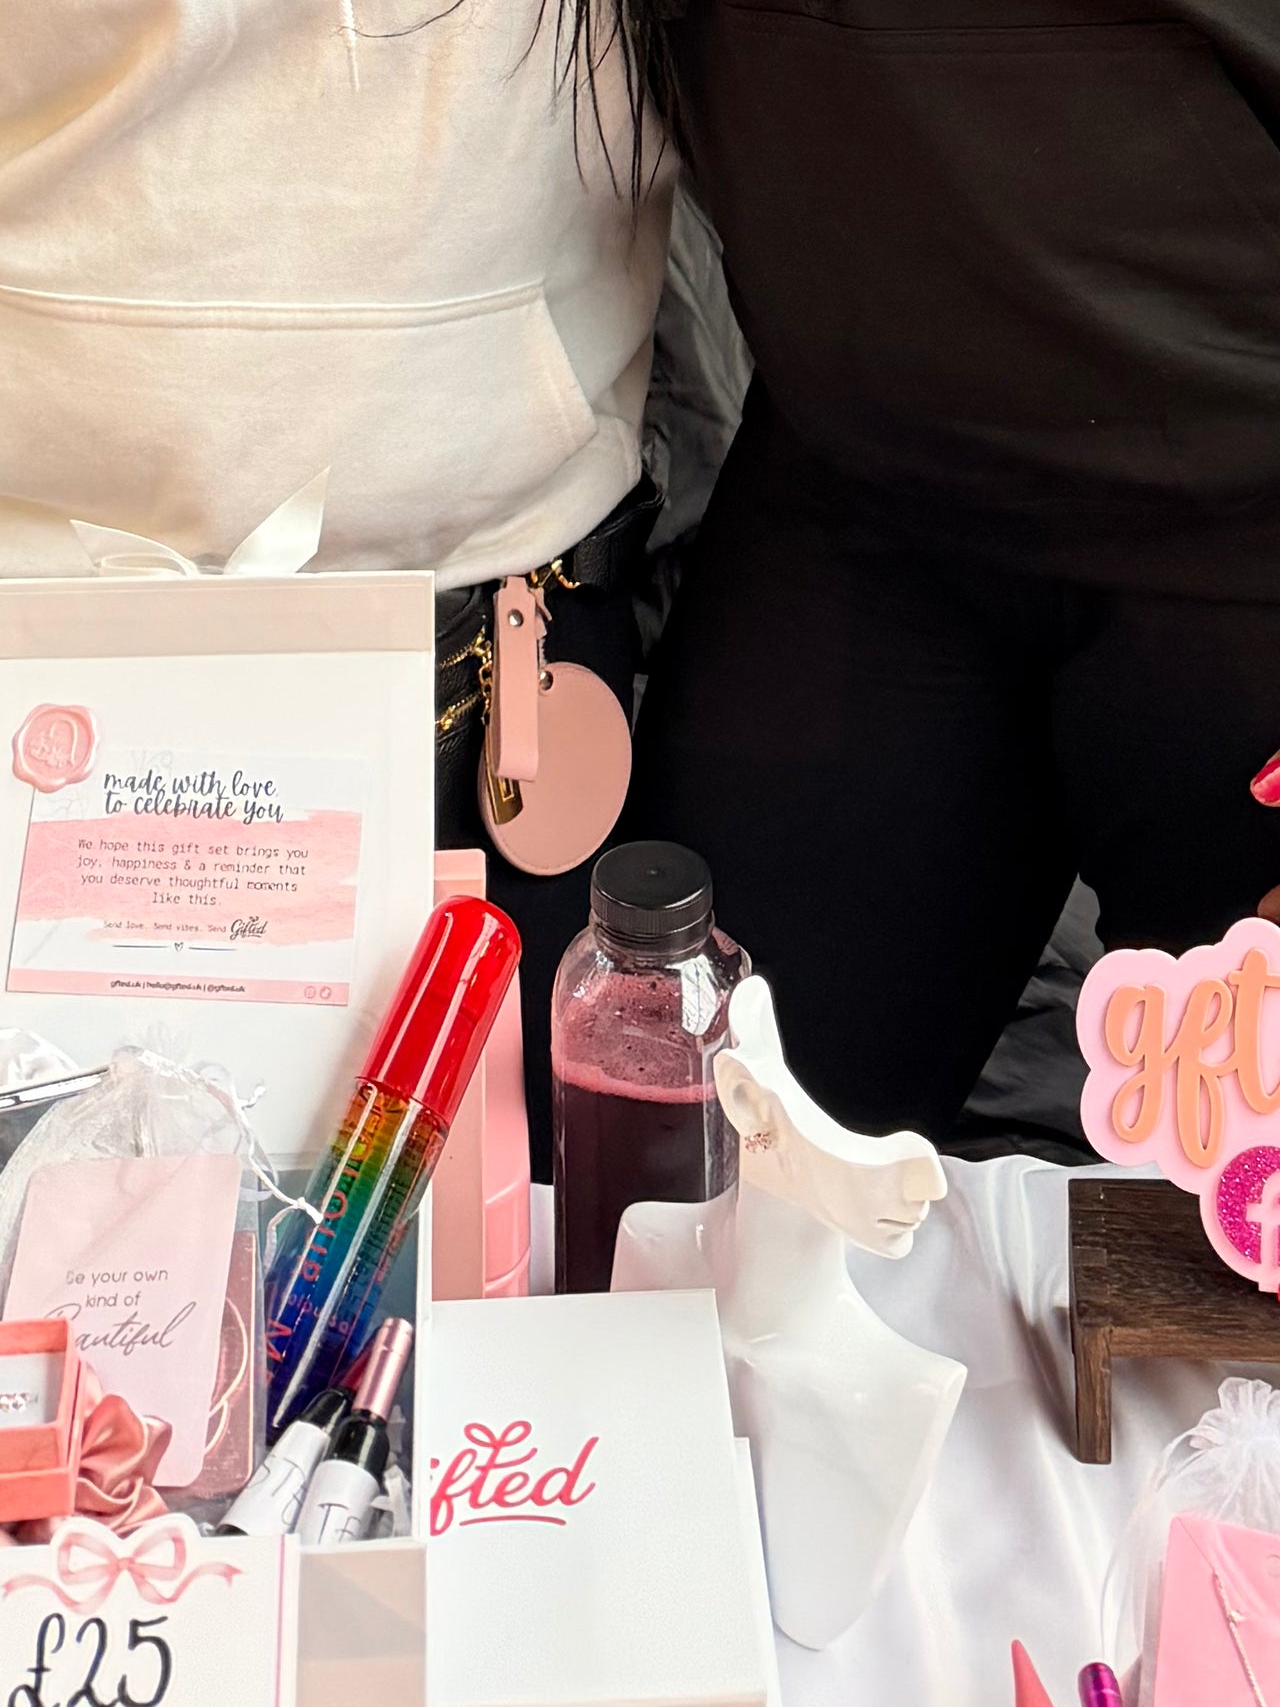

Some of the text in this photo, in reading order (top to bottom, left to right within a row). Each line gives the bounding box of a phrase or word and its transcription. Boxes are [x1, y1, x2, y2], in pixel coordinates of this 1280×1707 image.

[103, 769, 166, 795] made
[172, 770, 226, 797] with
[105, 789, 283, 825] to celebrate you
[100, 839, 129, 852] hope
[137, 841, 165, 853] this
[171, 843, 200, 857] gift
[208, 845, 229, 856] set
[236, 845, 280, 859] brings
[286, 848, 309, 860] you
[112, 856, 177, 871] happiness
[213, 862, 270, 874] reminder
[278, 864, 306, 876] that
[81, 874, 298, 892] you deserve thoughtful moments
[152, 892, 181, 905] like
[230, 915, 268, 941] Gifted
[91, 1270, 127, 1287] your
[133, 1269, 168, 1282] own
[85, 1291, 141, 1308] kind of
[44, 1301, 197, 1356] autiful
[7, 1612, 173, 1707] £25
